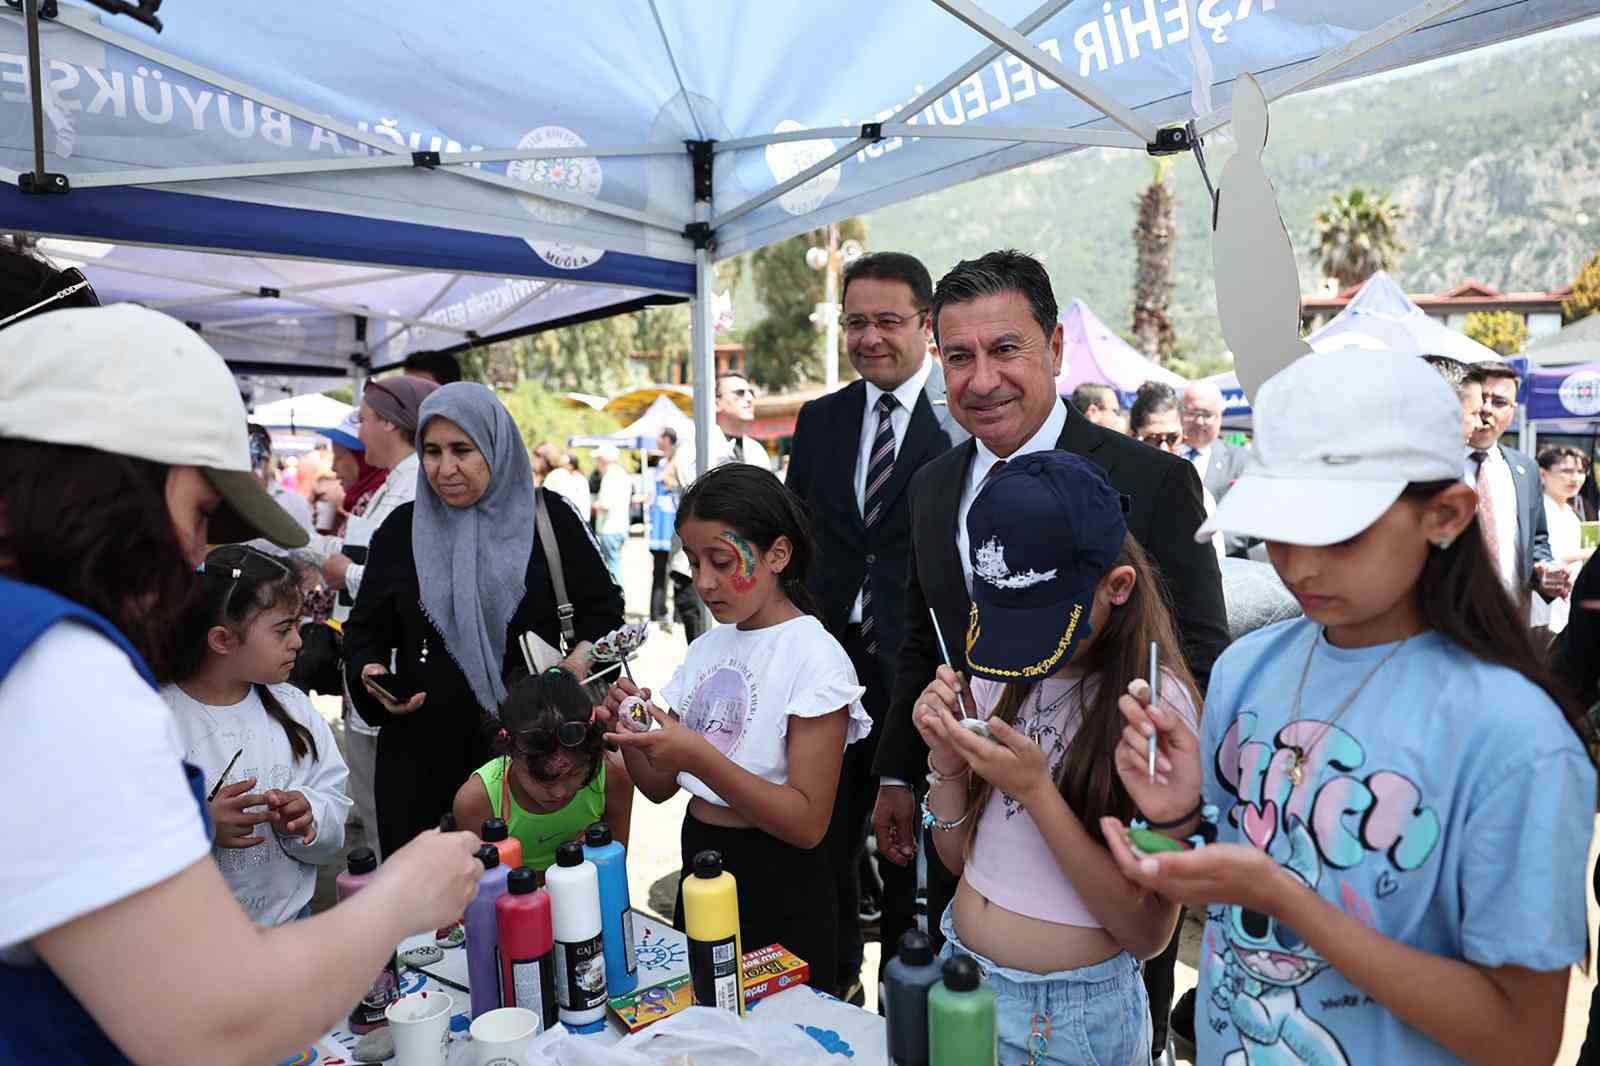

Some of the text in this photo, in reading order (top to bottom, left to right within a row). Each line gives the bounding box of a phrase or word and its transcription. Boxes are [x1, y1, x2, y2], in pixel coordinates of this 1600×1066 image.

[543, 250, 589, 267] MUĞLA
[1022, 661, 1044, 677] Türk
[743, 957, 760, 970] BOY
[743, 960, 785, 979] Bro
